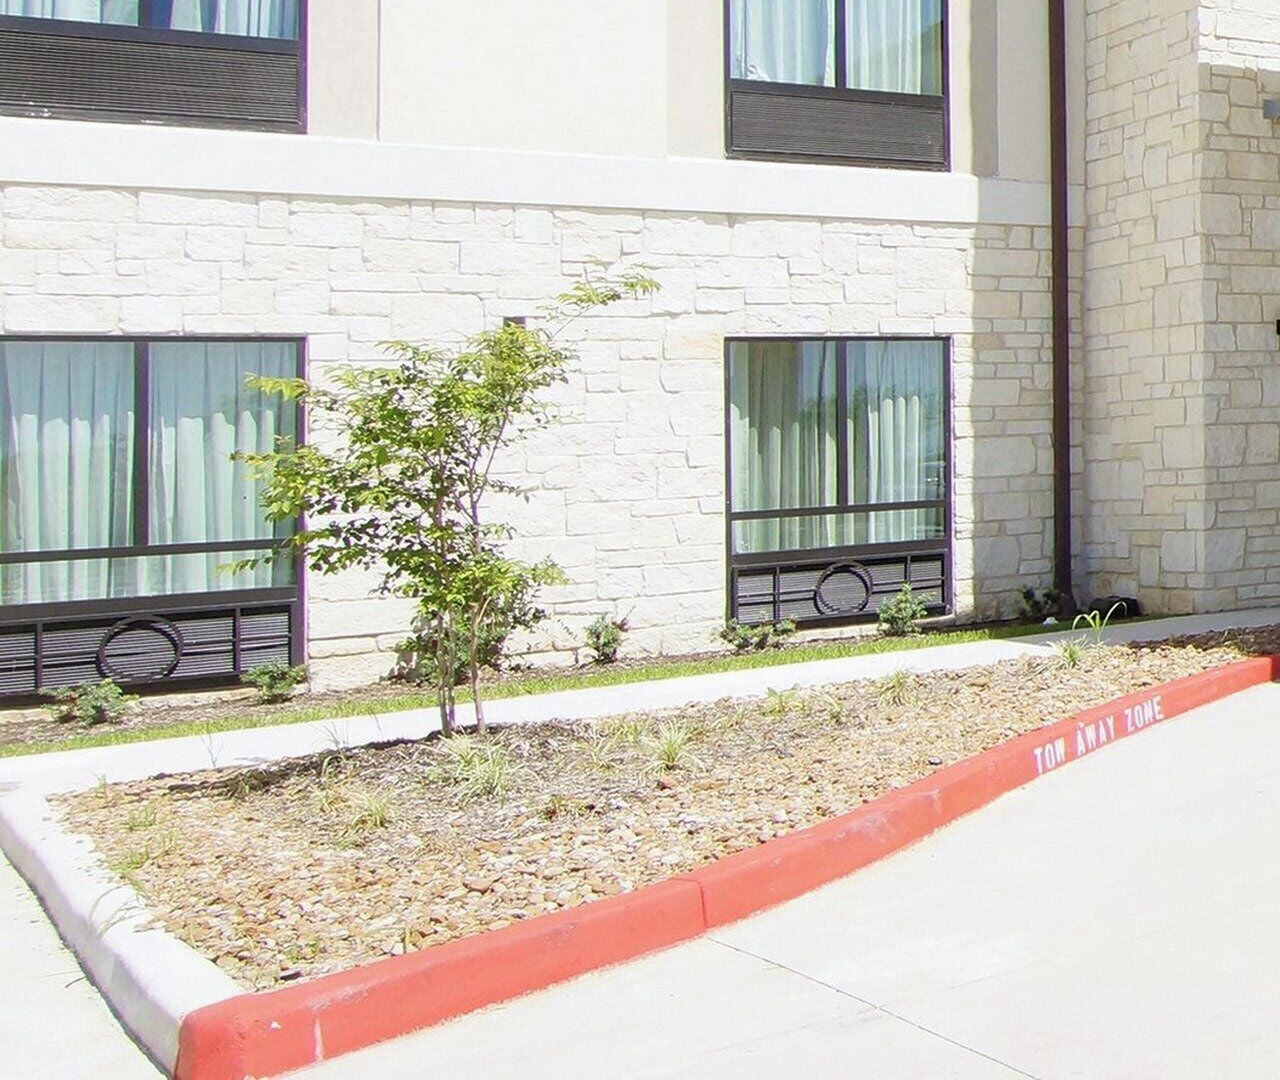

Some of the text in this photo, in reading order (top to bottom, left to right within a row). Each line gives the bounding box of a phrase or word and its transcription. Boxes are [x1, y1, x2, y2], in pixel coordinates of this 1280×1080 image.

[1033, 695, 1165, 774] TOW AWAY ZONE
